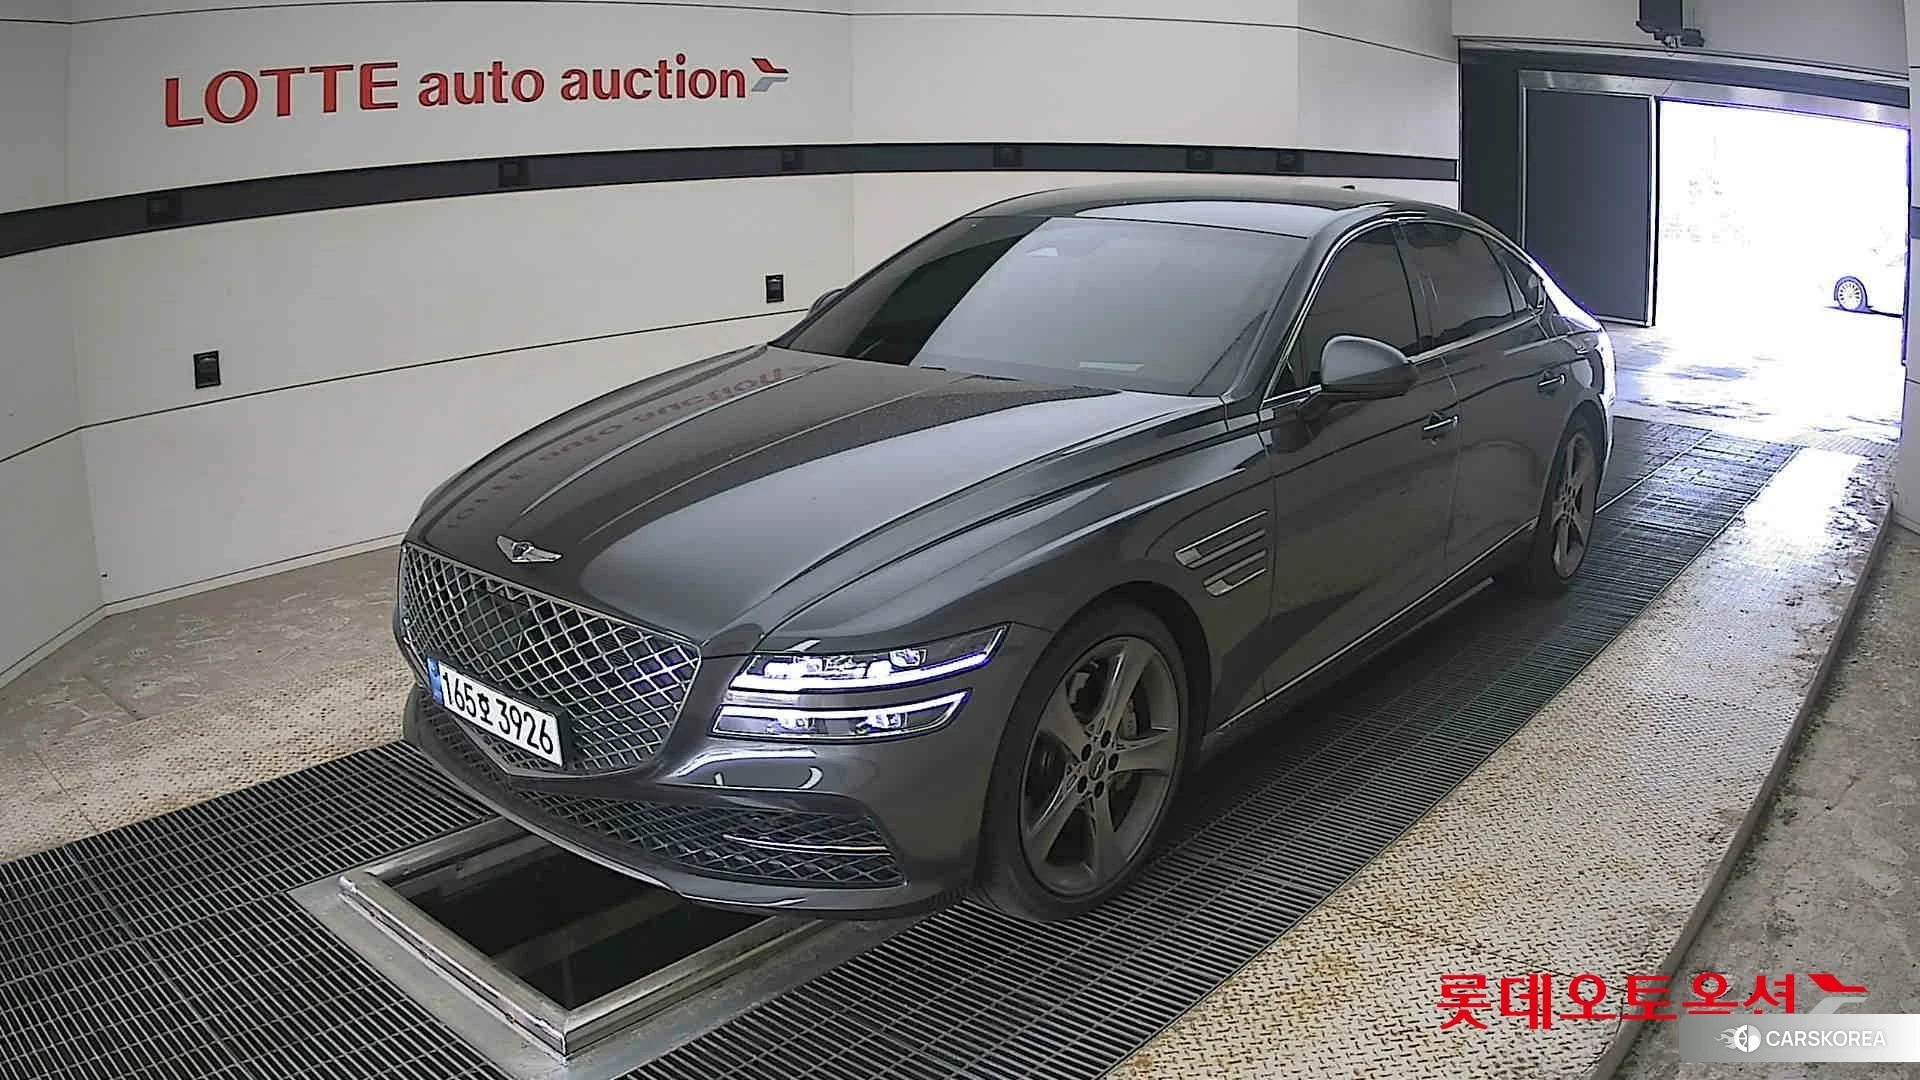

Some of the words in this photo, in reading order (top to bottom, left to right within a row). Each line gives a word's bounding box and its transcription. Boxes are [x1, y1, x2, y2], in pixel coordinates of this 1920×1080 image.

[164, 61, 399, 128] LOTTE
[418, 61, 546, 107] auto
[559, 53, 747, 101] auction
[496, 698, 554, 755] 3926
